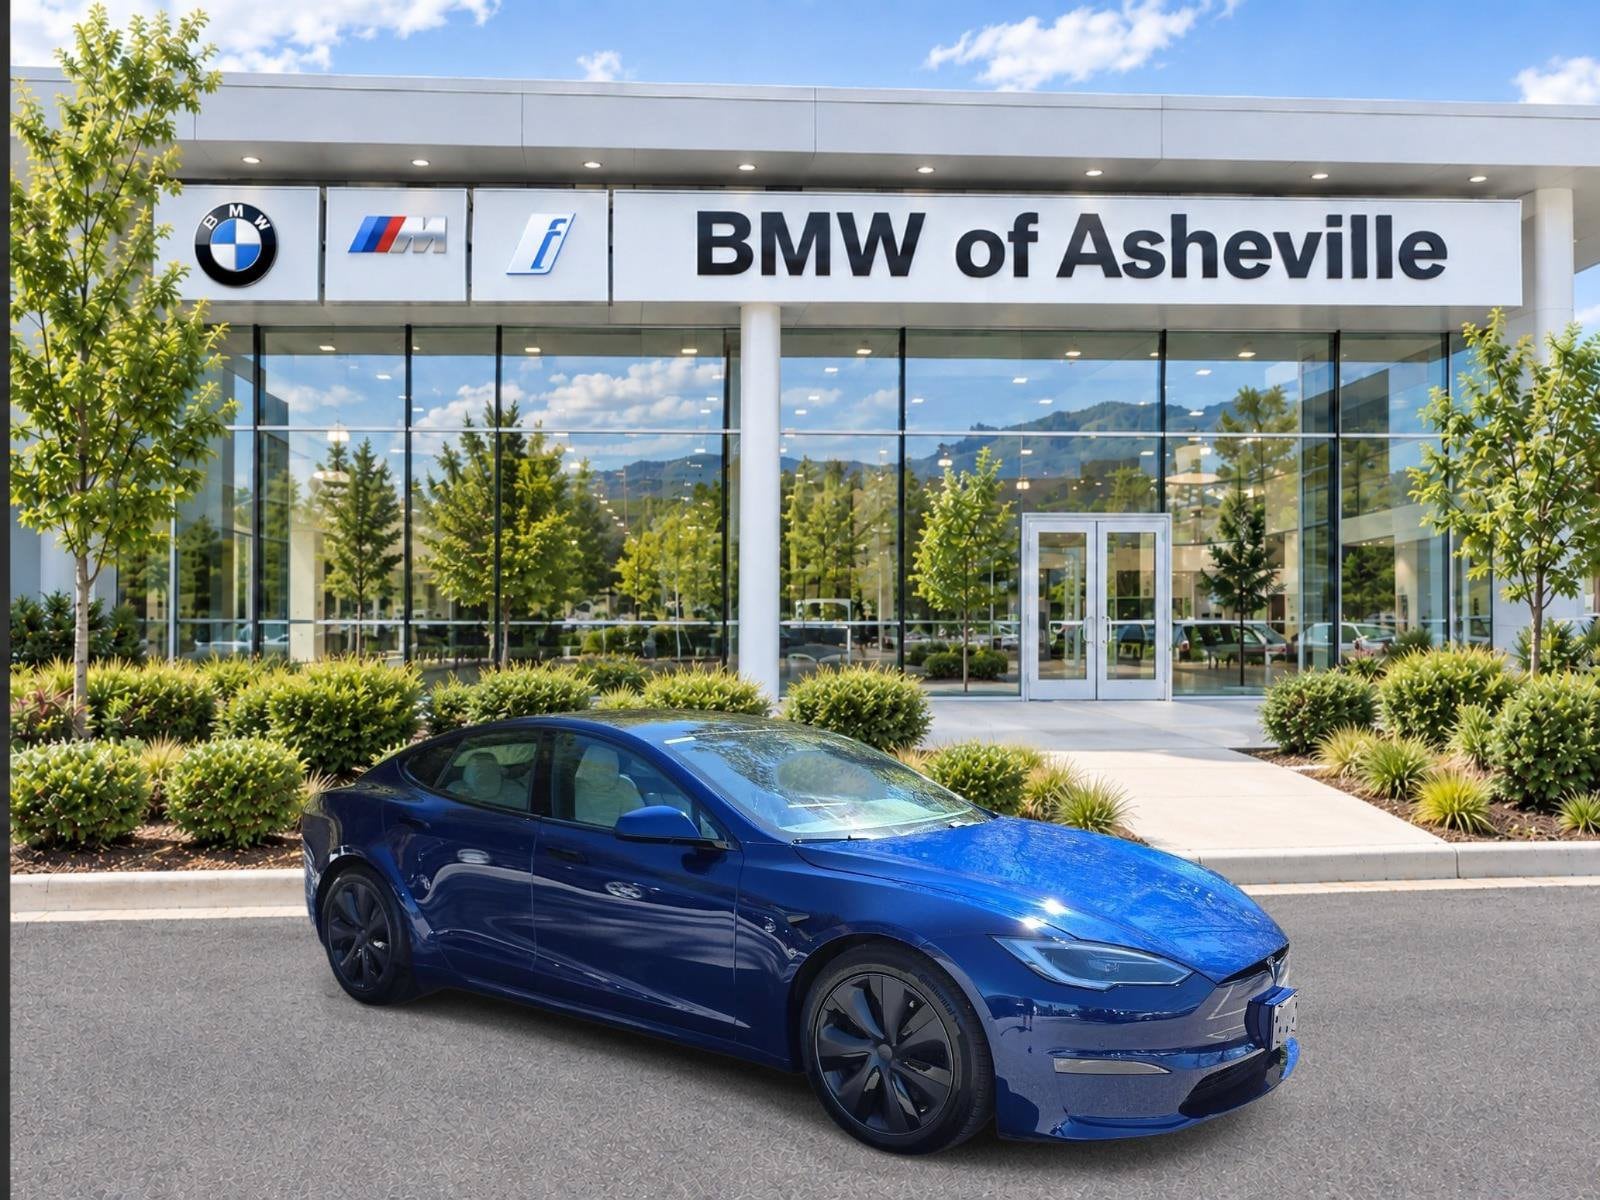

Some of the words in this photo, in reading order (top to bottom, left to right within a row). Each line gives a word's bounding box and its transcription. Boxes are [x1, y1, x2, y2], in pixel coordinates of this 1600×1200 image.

[202, 204, 271, 231] BMW
[696, 210, 926, 277] BMW
[955, 212, 1039, 279] of
[1057, 213, 1449, 280] Asheville
